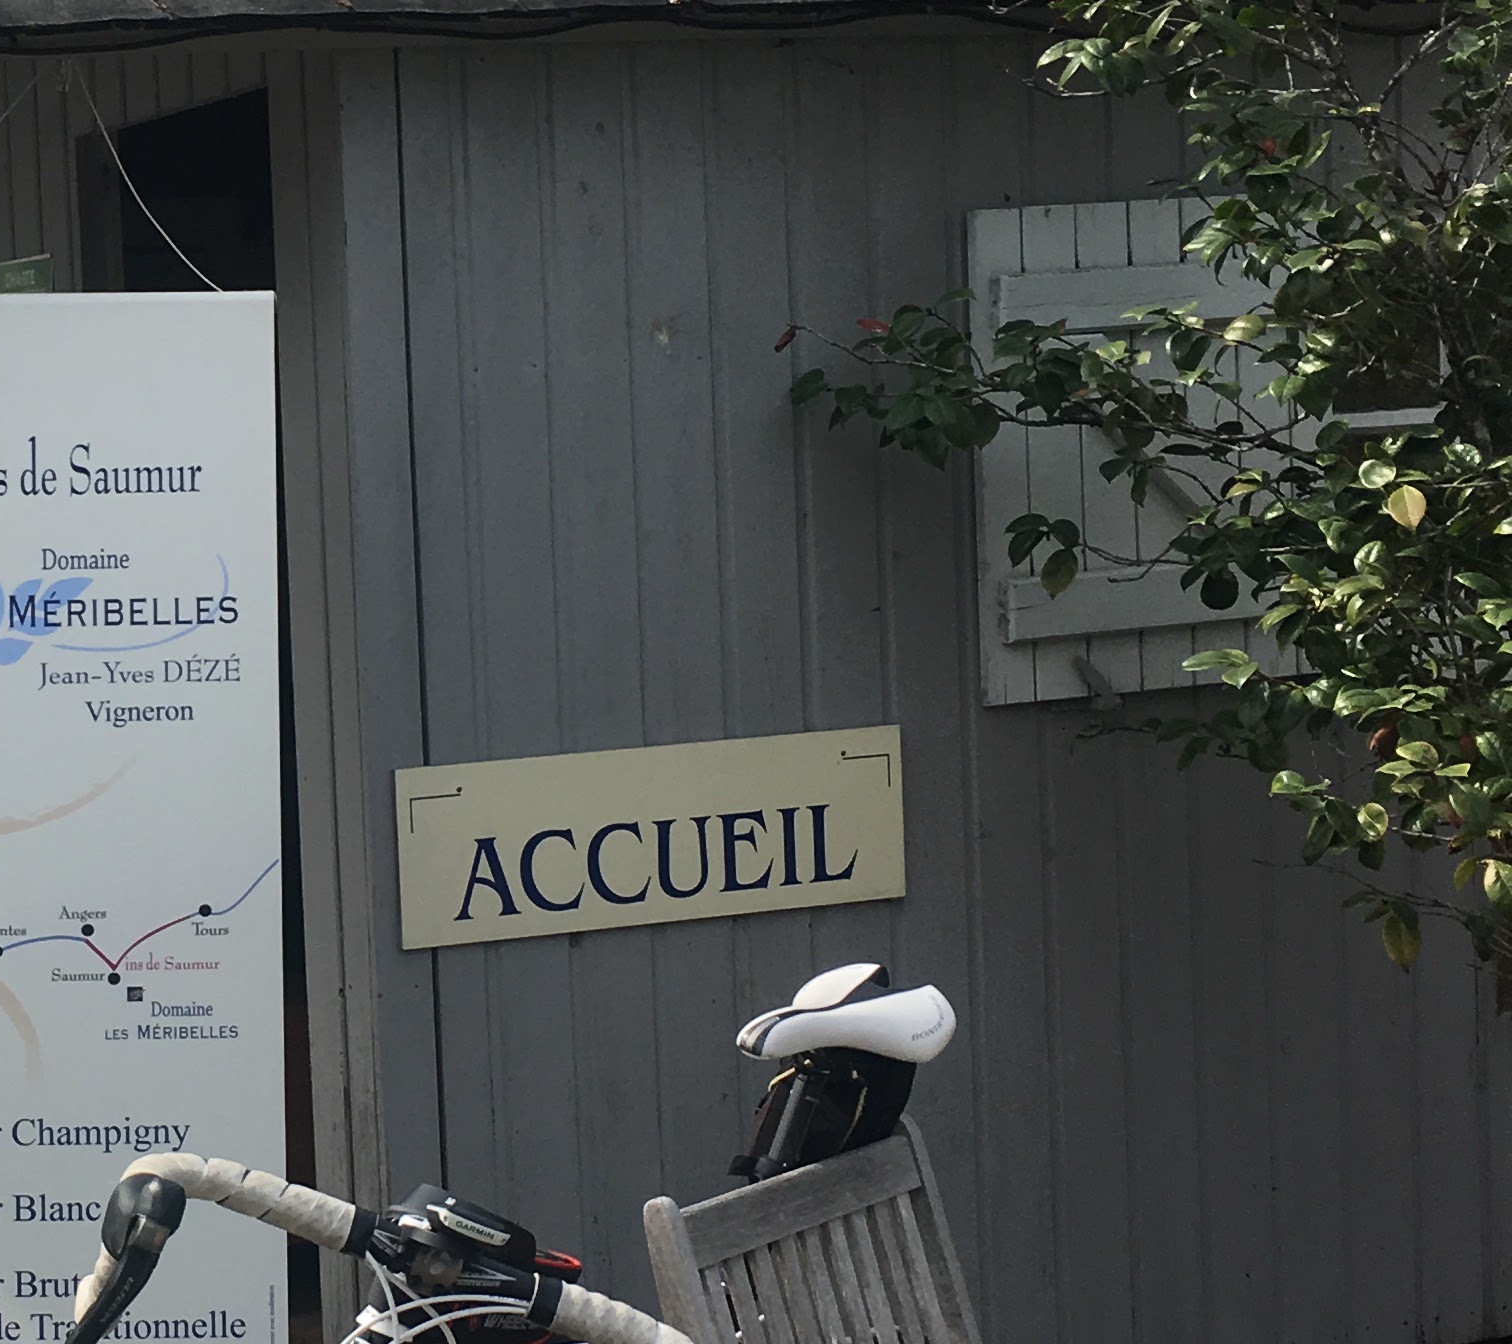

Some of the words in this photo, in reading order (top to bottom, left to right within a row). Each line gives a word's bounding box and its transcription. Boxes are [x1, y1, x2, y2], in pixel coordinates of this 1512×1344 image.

[20, 436, 58, 496] de
[69, 443, 202, 498] Saumur
[41, 548, 130, 572] Domaine
[8, 591, 240, 628] MÉRIBELLES
[37, 661, 156, 690] Jean-Yves
[162, 653, 241, 683] DÉZÉ
[85, 700, 195, 728] Vigneron
[453, 804, 858, 922] ACCUEIL
[59, 906, 107, 922] Angers
[192, 922, 230, 936] Tours
[51, 969, 105, 983] Saumur
[163, 958, 220, 972] Saumur
[151, 1001, 214, 1017] Domaine
[105, 1028, 128, 1041] LES
[137, 1023, 239, 1041] MÉRIBELLES
[12, 1117, 191, 1154] Champigny
[13, 1195, 102, 1222] Blanc
[455, 1219, 496, 1241] GARMIN
[14, 1271, 80, 1298] Brut
[30, 1311, 248, 1343] Trationnelle
